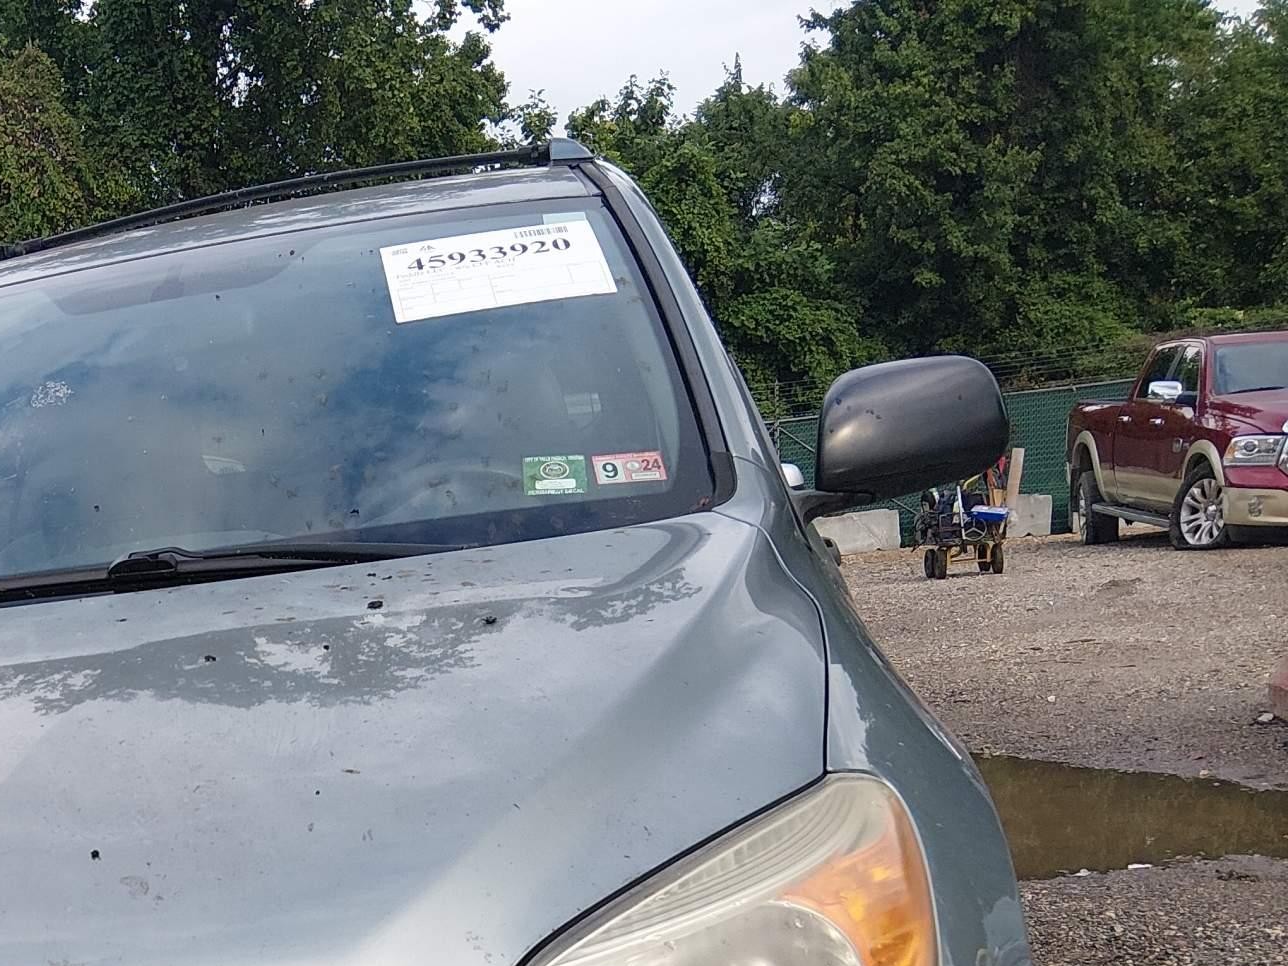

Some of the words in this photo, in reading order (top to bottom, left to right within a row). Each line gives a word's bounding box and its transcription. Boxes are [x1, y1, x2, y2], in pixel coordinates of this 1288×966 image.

[407, 237, 571, 271] 45933920
[602, 462, 619, 478] 9
[641, 458, 662, 471] 24
